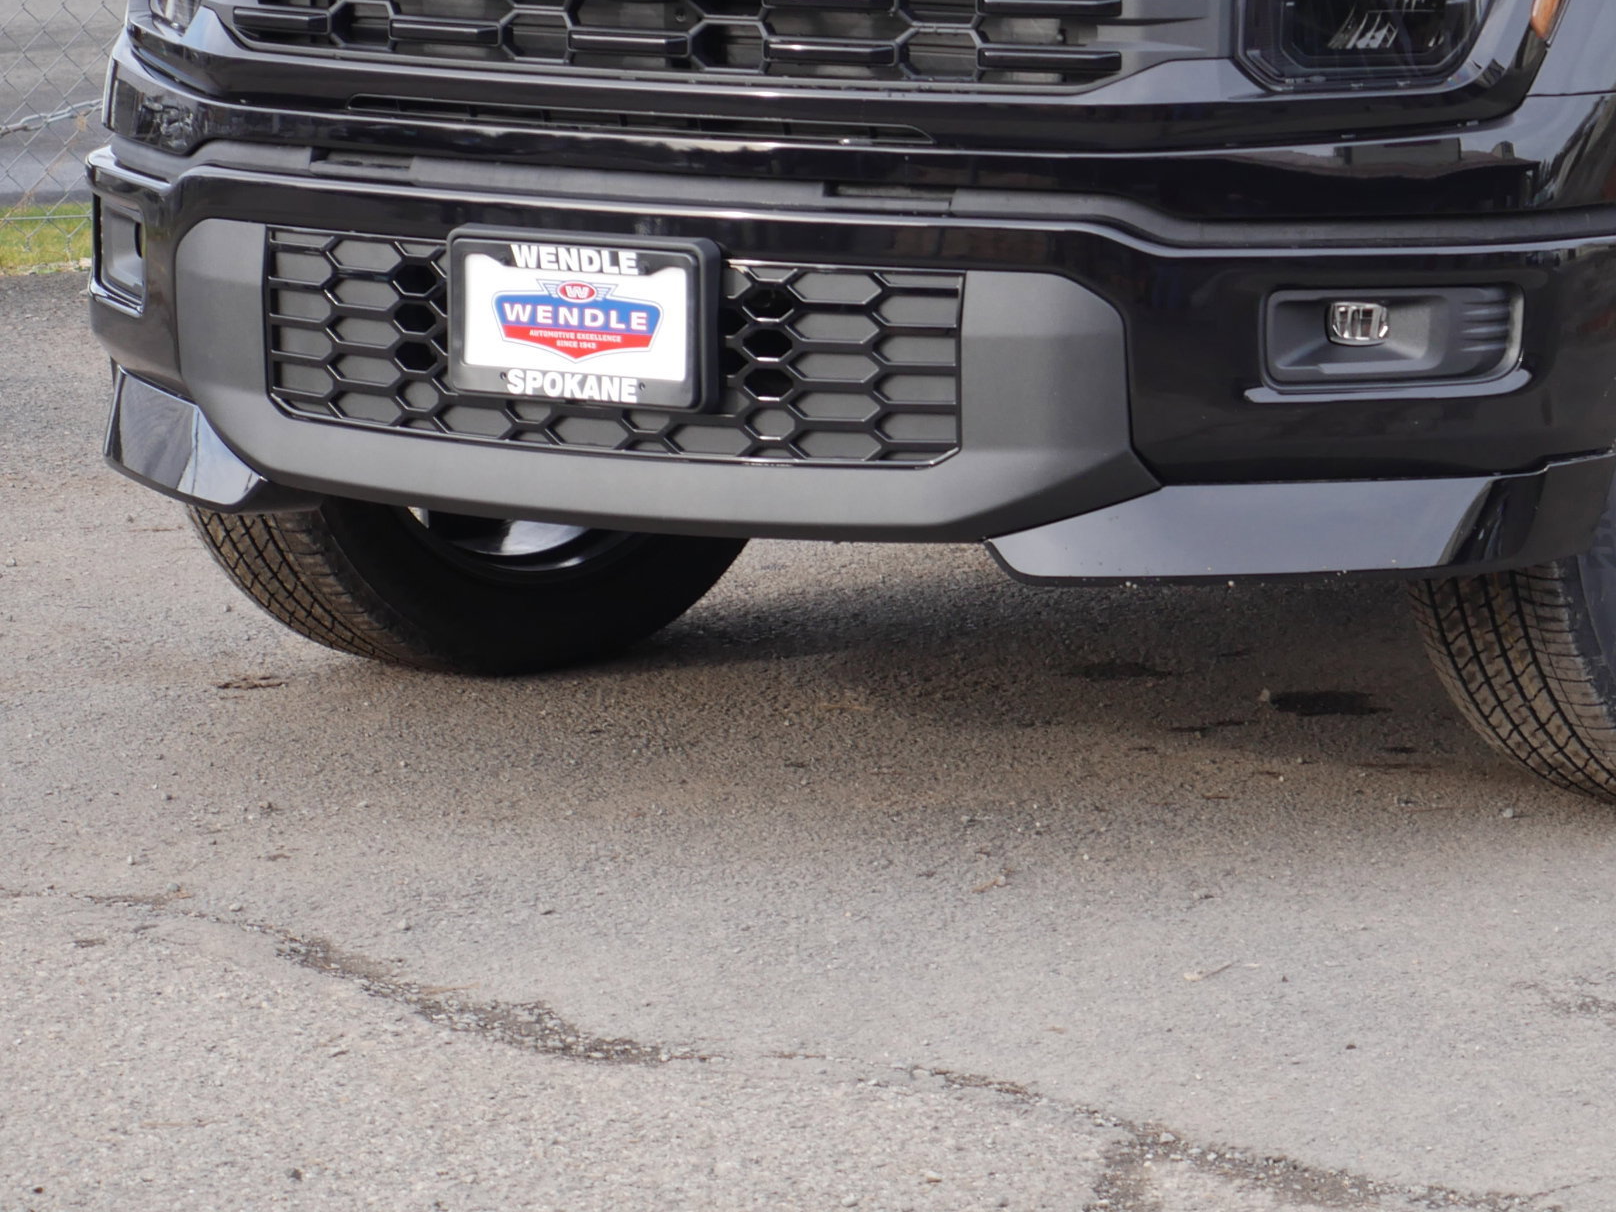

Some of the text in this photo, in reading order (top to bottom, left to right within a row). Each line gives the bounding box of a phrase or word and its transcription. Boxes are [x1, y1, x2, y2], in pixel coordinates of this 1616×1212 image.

[510, 244, 639, 276] WENDLE
[502, 302, 648, 331] WENDLE
[529, 329, 622, 343] AUTOMOTIVE EXCELLENCE
[506, 368, 638, 404] SPOKANE
